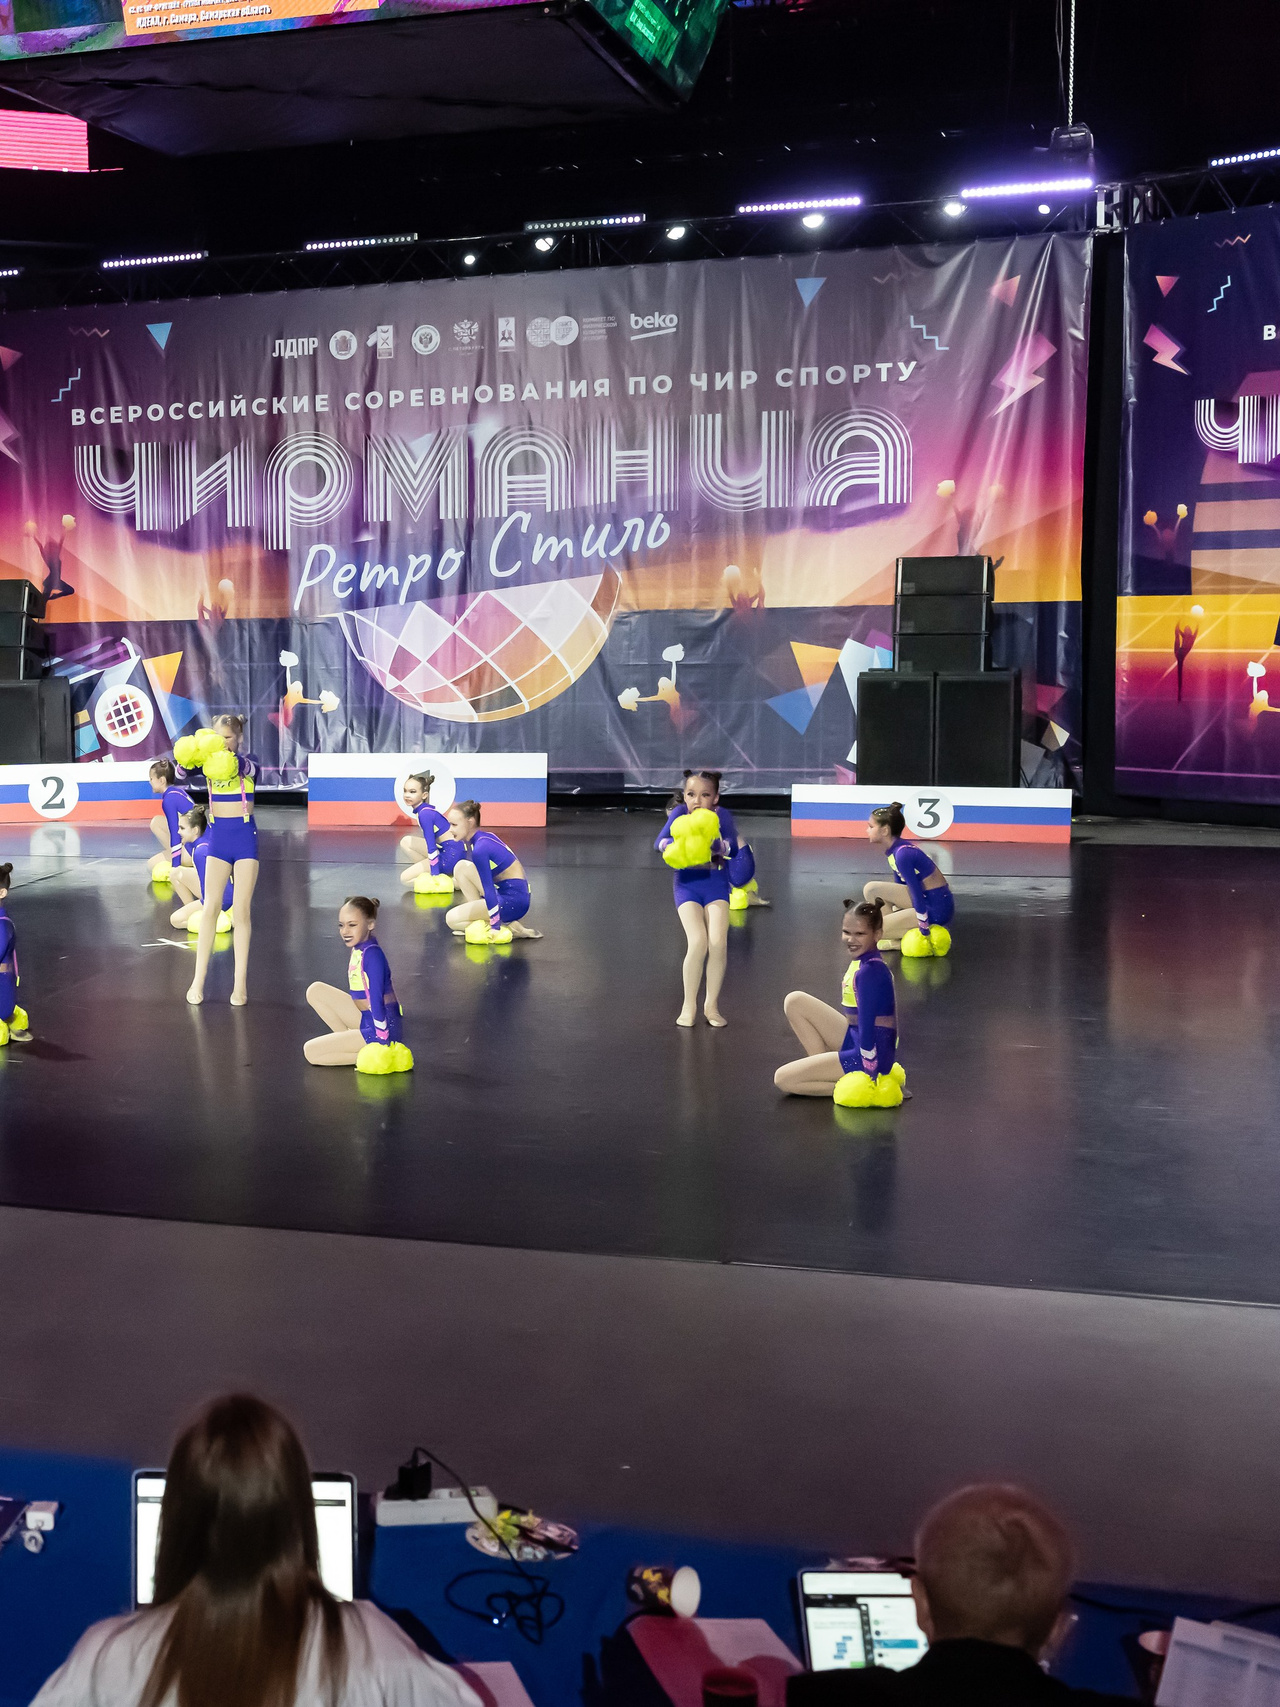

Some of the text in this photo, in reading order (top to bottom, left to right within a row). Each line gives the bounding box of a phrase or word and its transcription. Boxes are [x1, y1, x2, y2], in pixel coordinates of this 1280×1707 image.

[630, 312, 678, 329] beko
[272, 337, 318, 359] ЛДПР
[71, 361, 917, 426] ВСЕРОССИЙСКИЕ СОРЕВНОВАНИЯ ПО ЧИР СПОРТУ
[294, 511, 671, 611] Ретро Стиль
[41, 776, 66, 809] 2
[917, 798, 940, 829] 3
